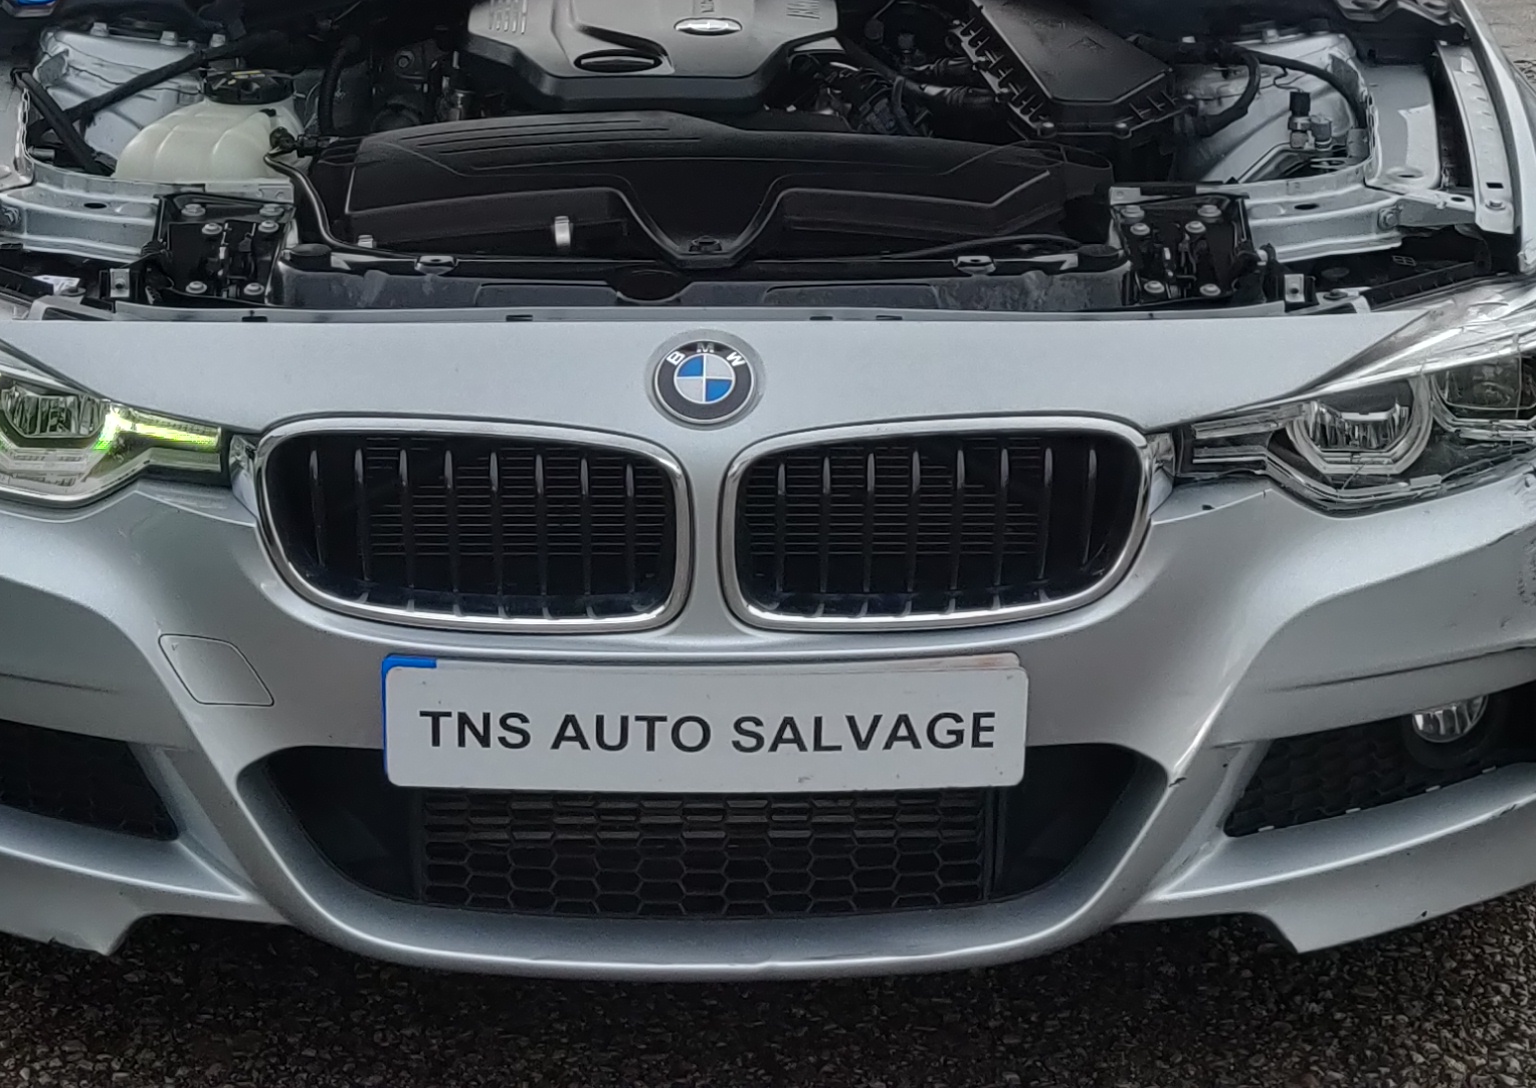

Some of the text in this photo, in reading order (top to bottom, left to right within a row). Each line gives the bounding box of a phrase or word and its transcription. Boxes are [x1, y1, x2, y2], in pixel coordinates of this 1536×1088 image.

[665, 342, 746, 367] BMW
[419, 710, 996, 754] TNS AUTO SALVAGE
